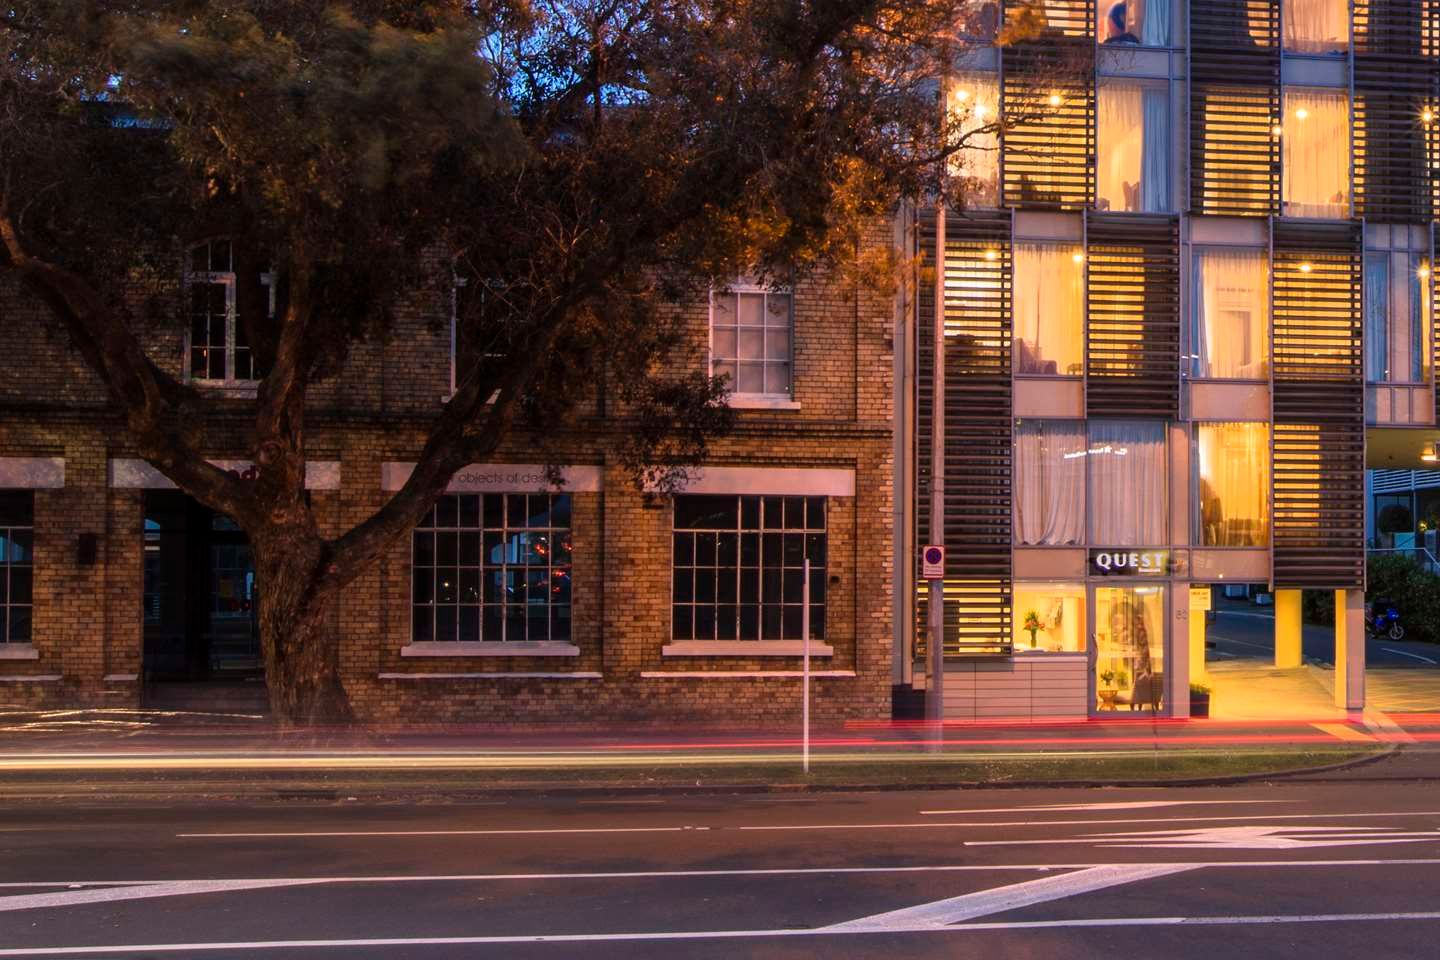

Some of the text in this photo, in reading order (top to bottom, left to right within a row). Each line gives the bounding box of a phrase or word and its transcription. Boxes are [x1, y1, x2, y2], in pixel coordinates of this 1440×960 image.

[458, 471, 501, 487] objects
[506, 471, 520, 483] of
[1096, 553, 1163, 570] QUEST
